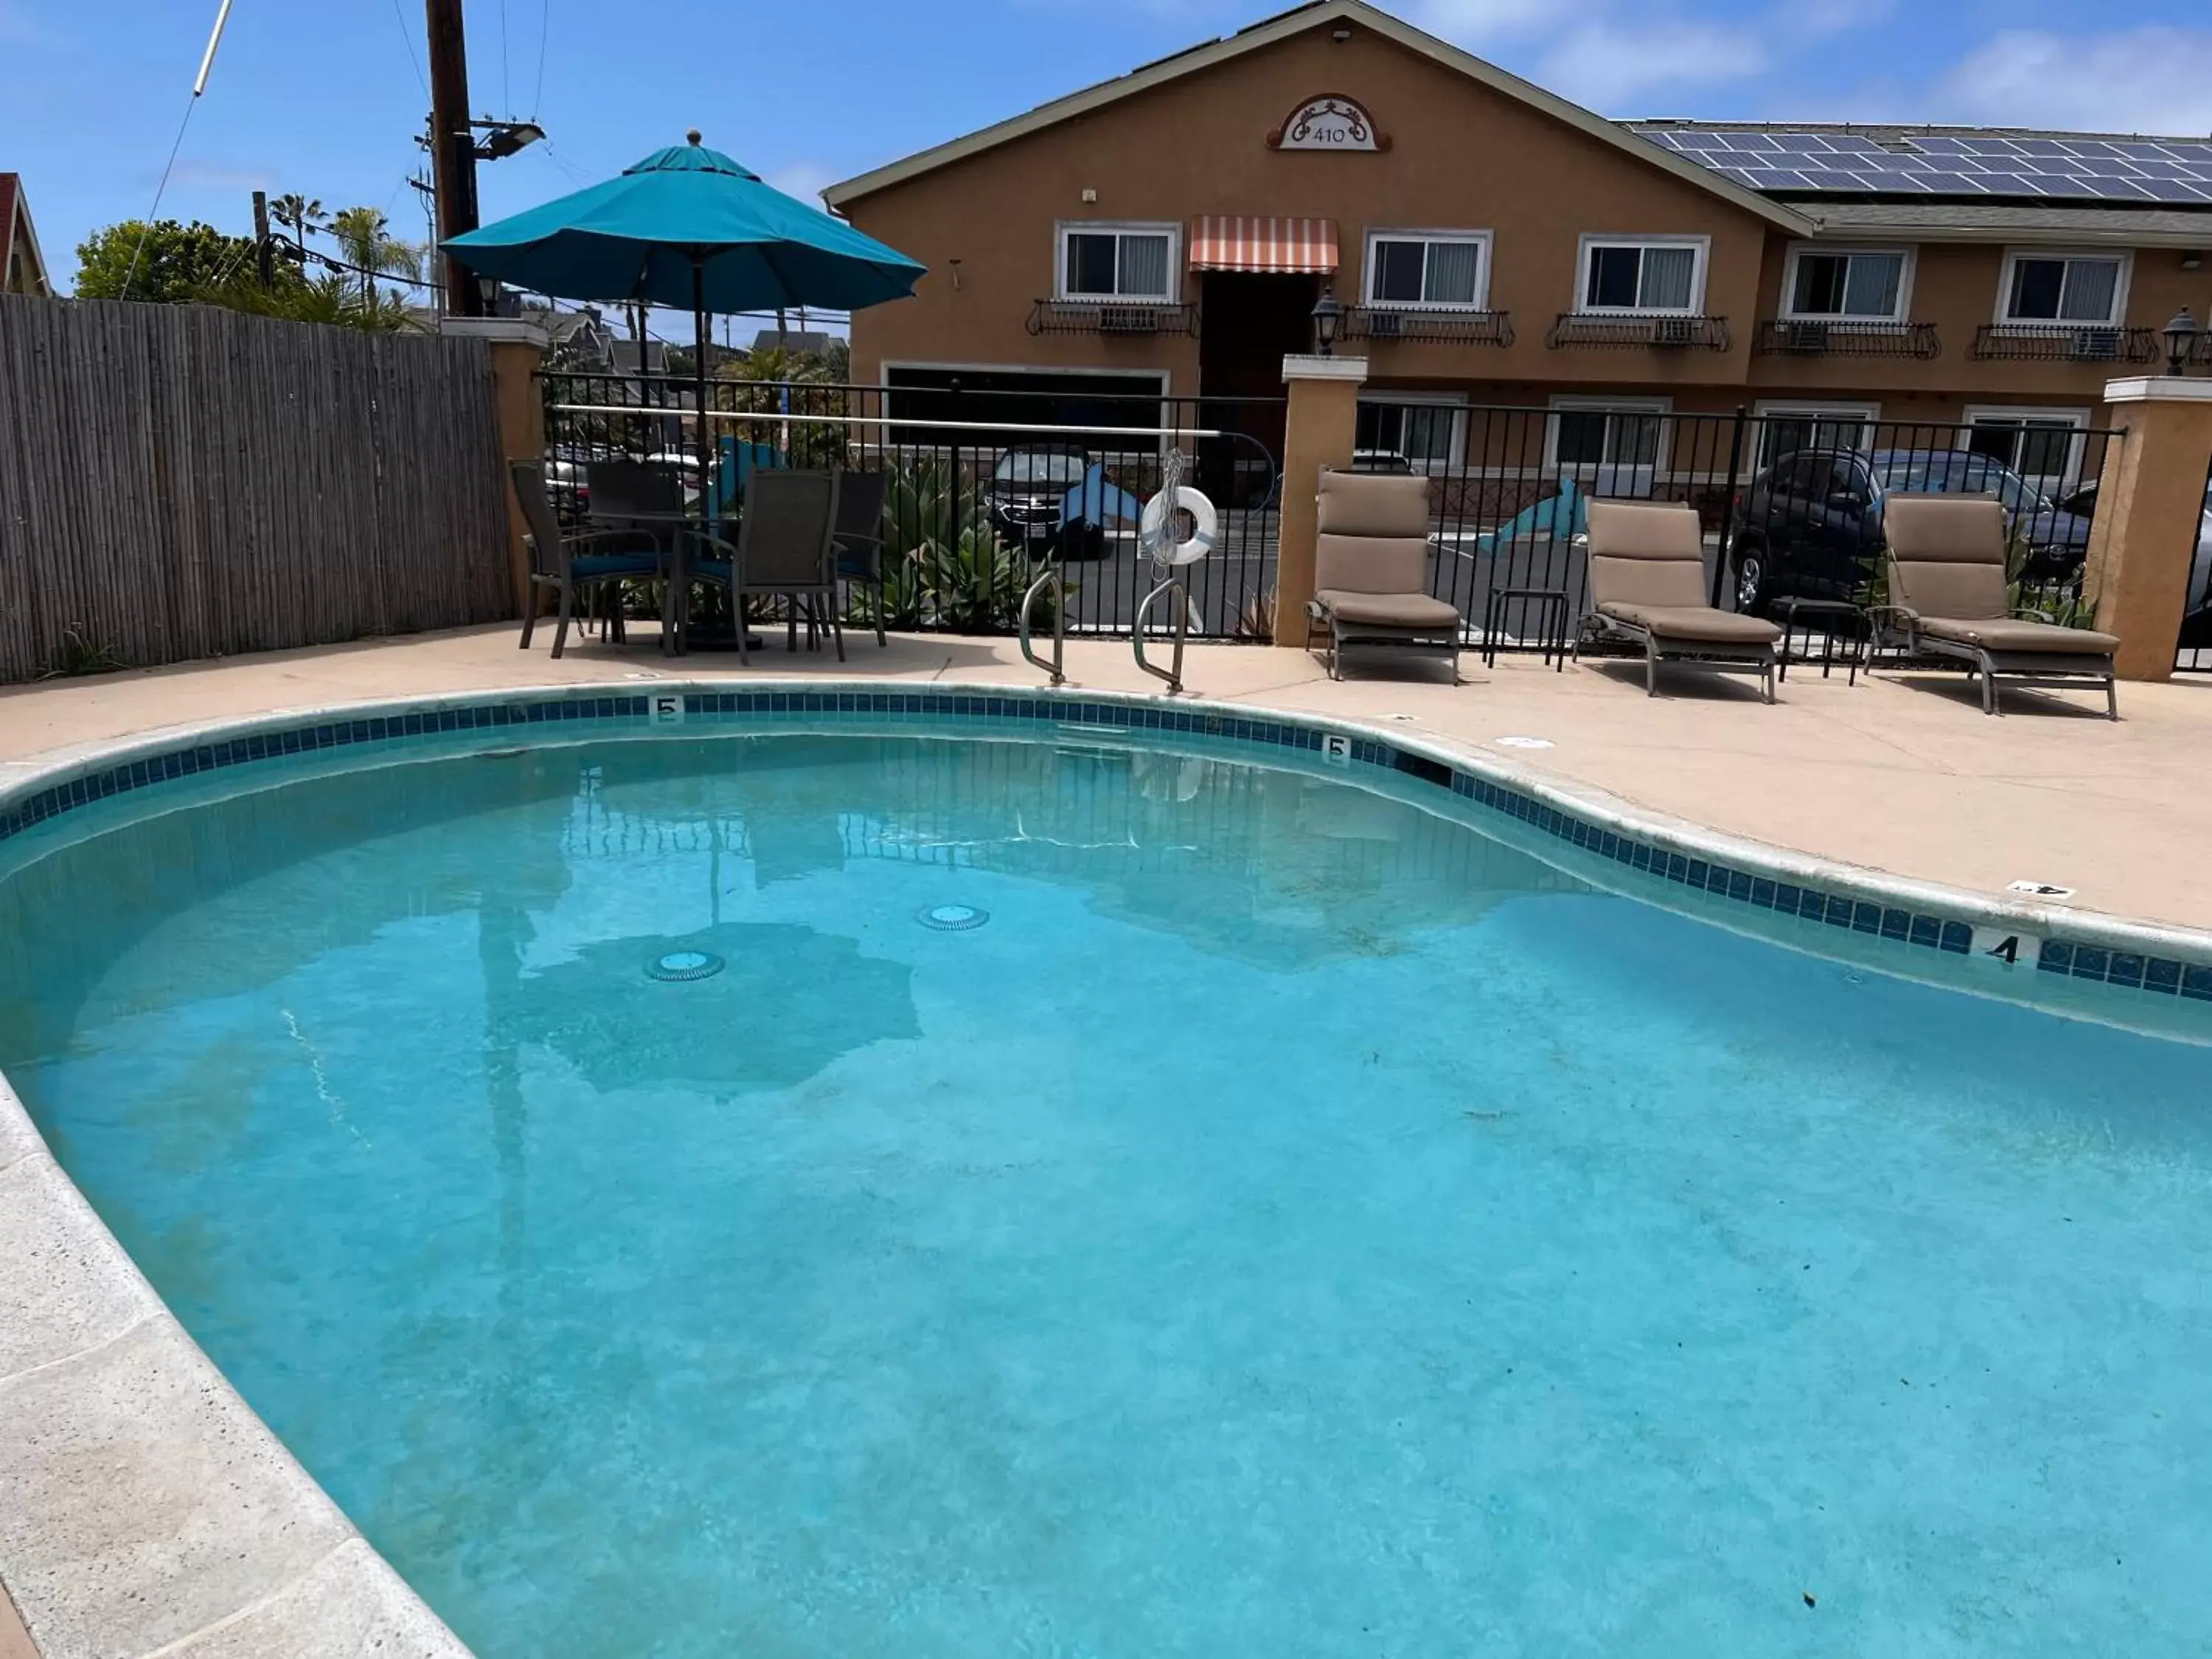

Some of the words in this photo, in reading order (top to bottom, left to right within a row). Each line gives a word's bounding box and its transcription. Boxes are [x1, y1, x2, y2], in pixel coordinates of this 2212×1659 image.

[1313, 128, 1345, 142] 410
[657, 698, 676, 714] 5
[1329, 737, 1344, 755] 5
[1985, 936, 2020, 964] 4
